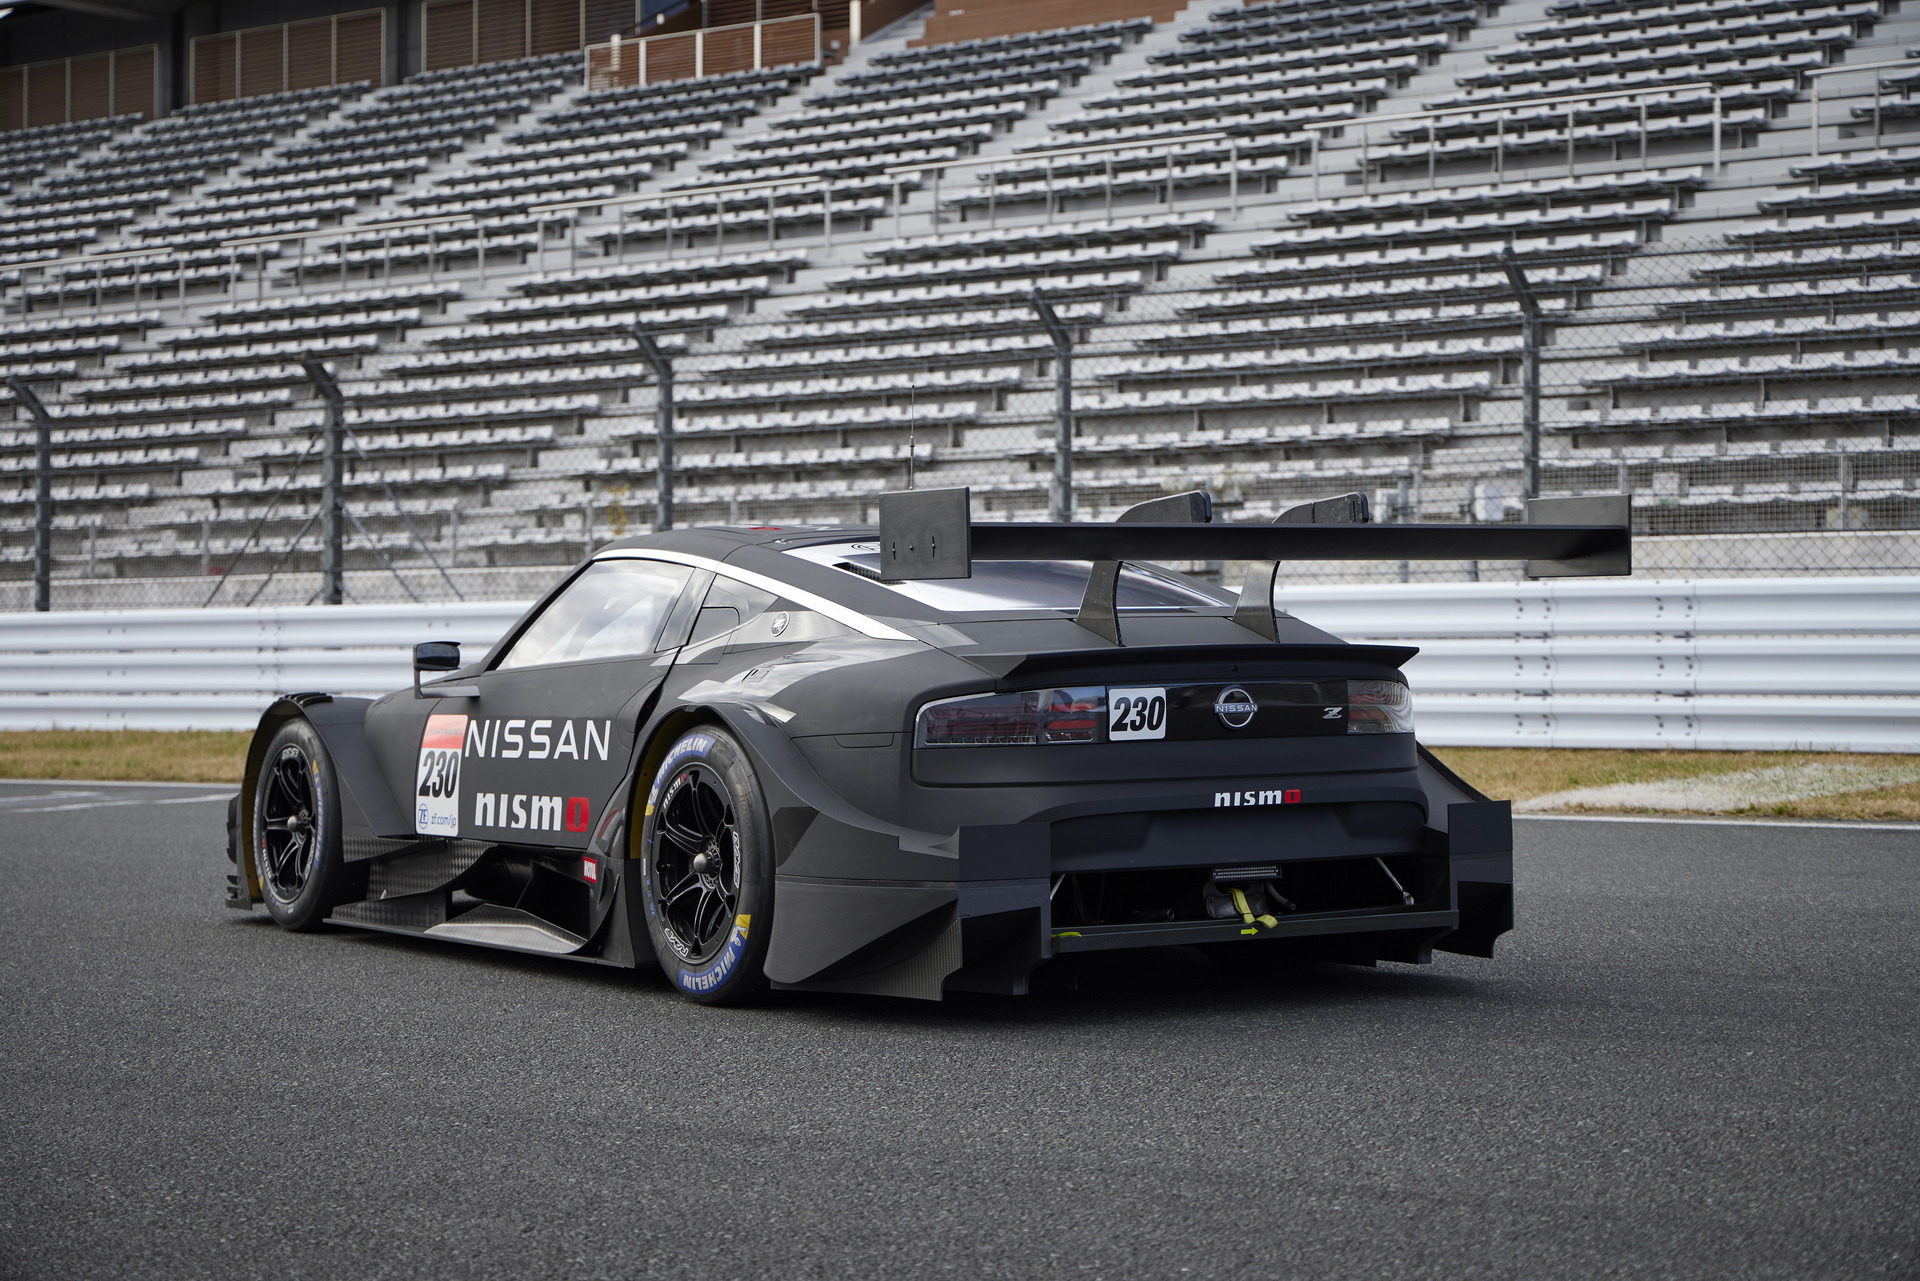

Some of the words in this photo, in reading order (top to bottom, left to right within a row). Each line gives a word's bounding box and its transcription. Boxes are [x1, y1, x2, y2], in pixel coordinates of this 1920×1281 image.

[1111, 696, 1165, 732] 230
[1215, 704, 1257, 712] NISSAN
[1323, 707, 1342, 719] Z
[465, 720, 611, 761] NISSAN
[657, 737, 707, 784] MICHELIN
[418, 751, 459, 798] 230
[475, 792, 590, 832] nismo
[1214, 789, 1301, 807] nismo
[683, 946, 736, 990] MICHELIN
